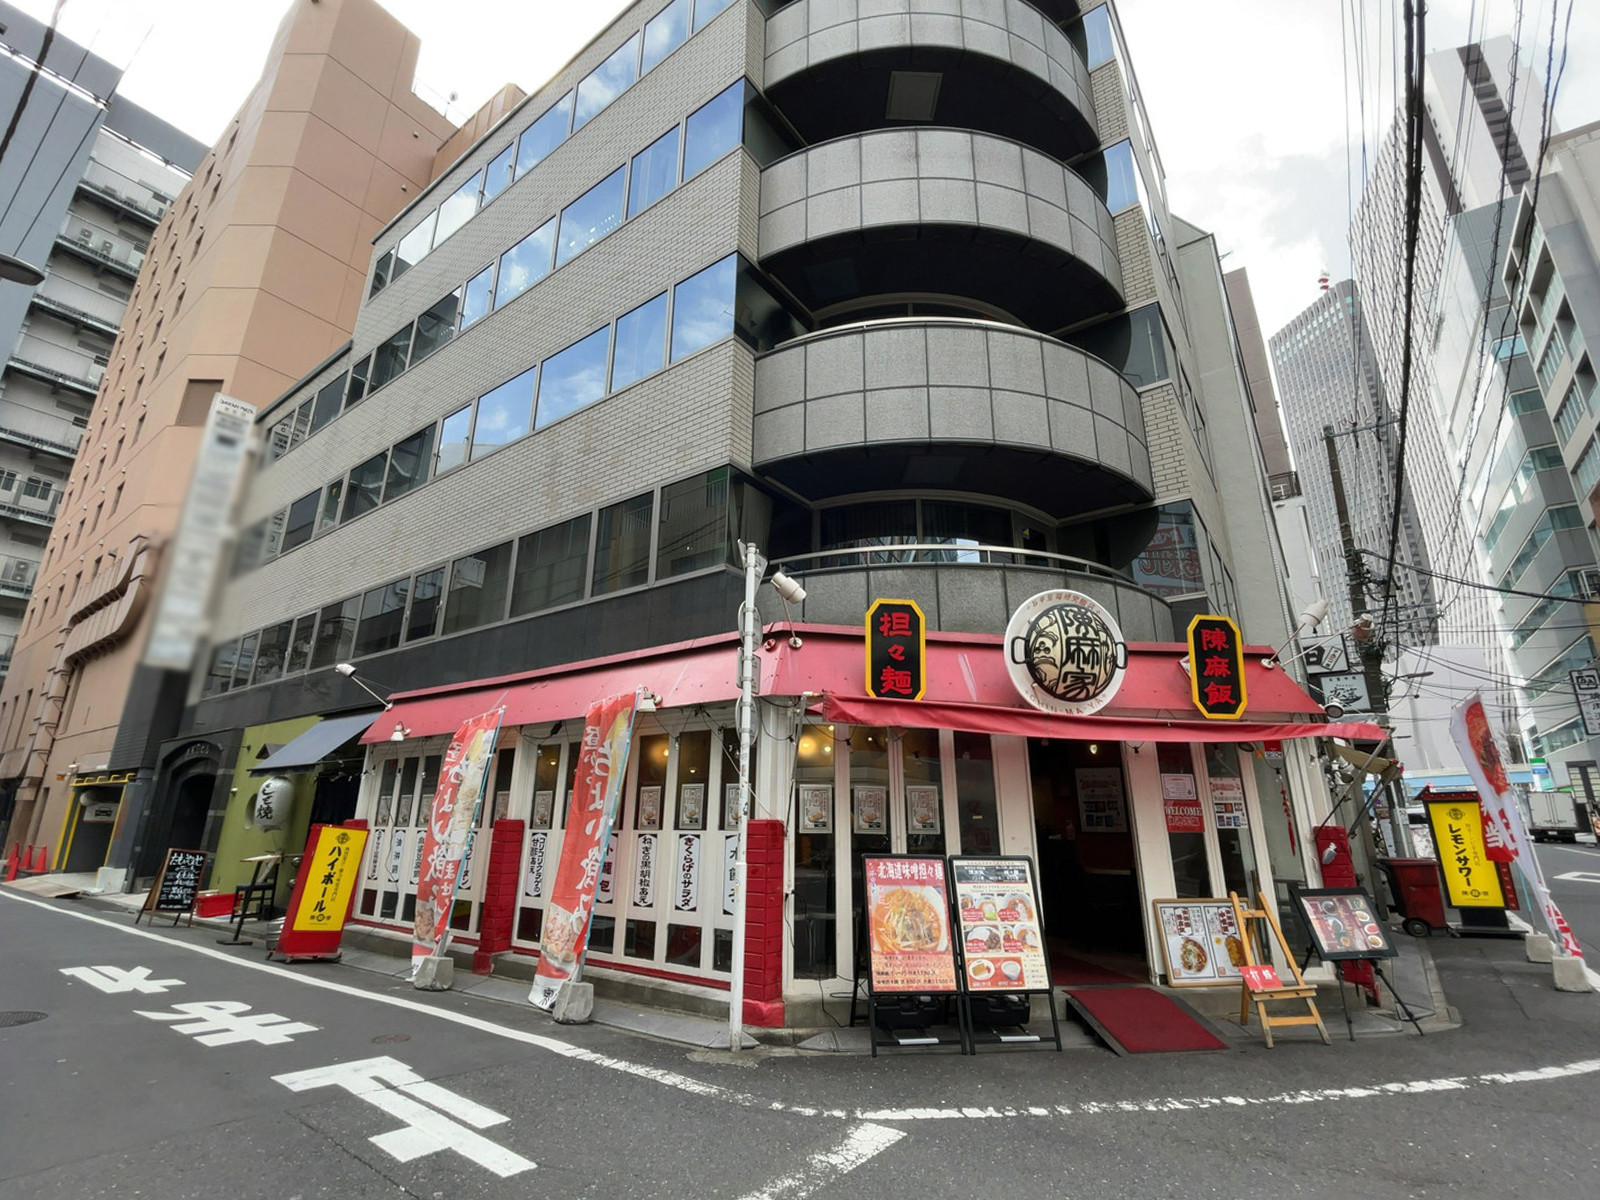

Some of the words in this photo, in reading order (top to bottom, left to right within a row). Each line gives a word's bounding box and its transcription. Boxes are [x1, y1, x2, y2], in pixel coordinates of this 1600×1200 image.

[879, 611, 913, 695] 担々麺
[1200, 627, 1237, 706] 陳麻飯
[257, 783, 274, 820] どて焼
[1165, 804, 1204, 816] WELCOME
[313, 845, 342, 913] ハイボール
[638, 835, 653, 904] ねぎの黒胡椒あえ
[681, 836, 696, 907] きくらげのサラダ
[877, 862, 944, 880] 北海道味噌担々麺
[1447, 823, 1472, 887] レモンサワー
